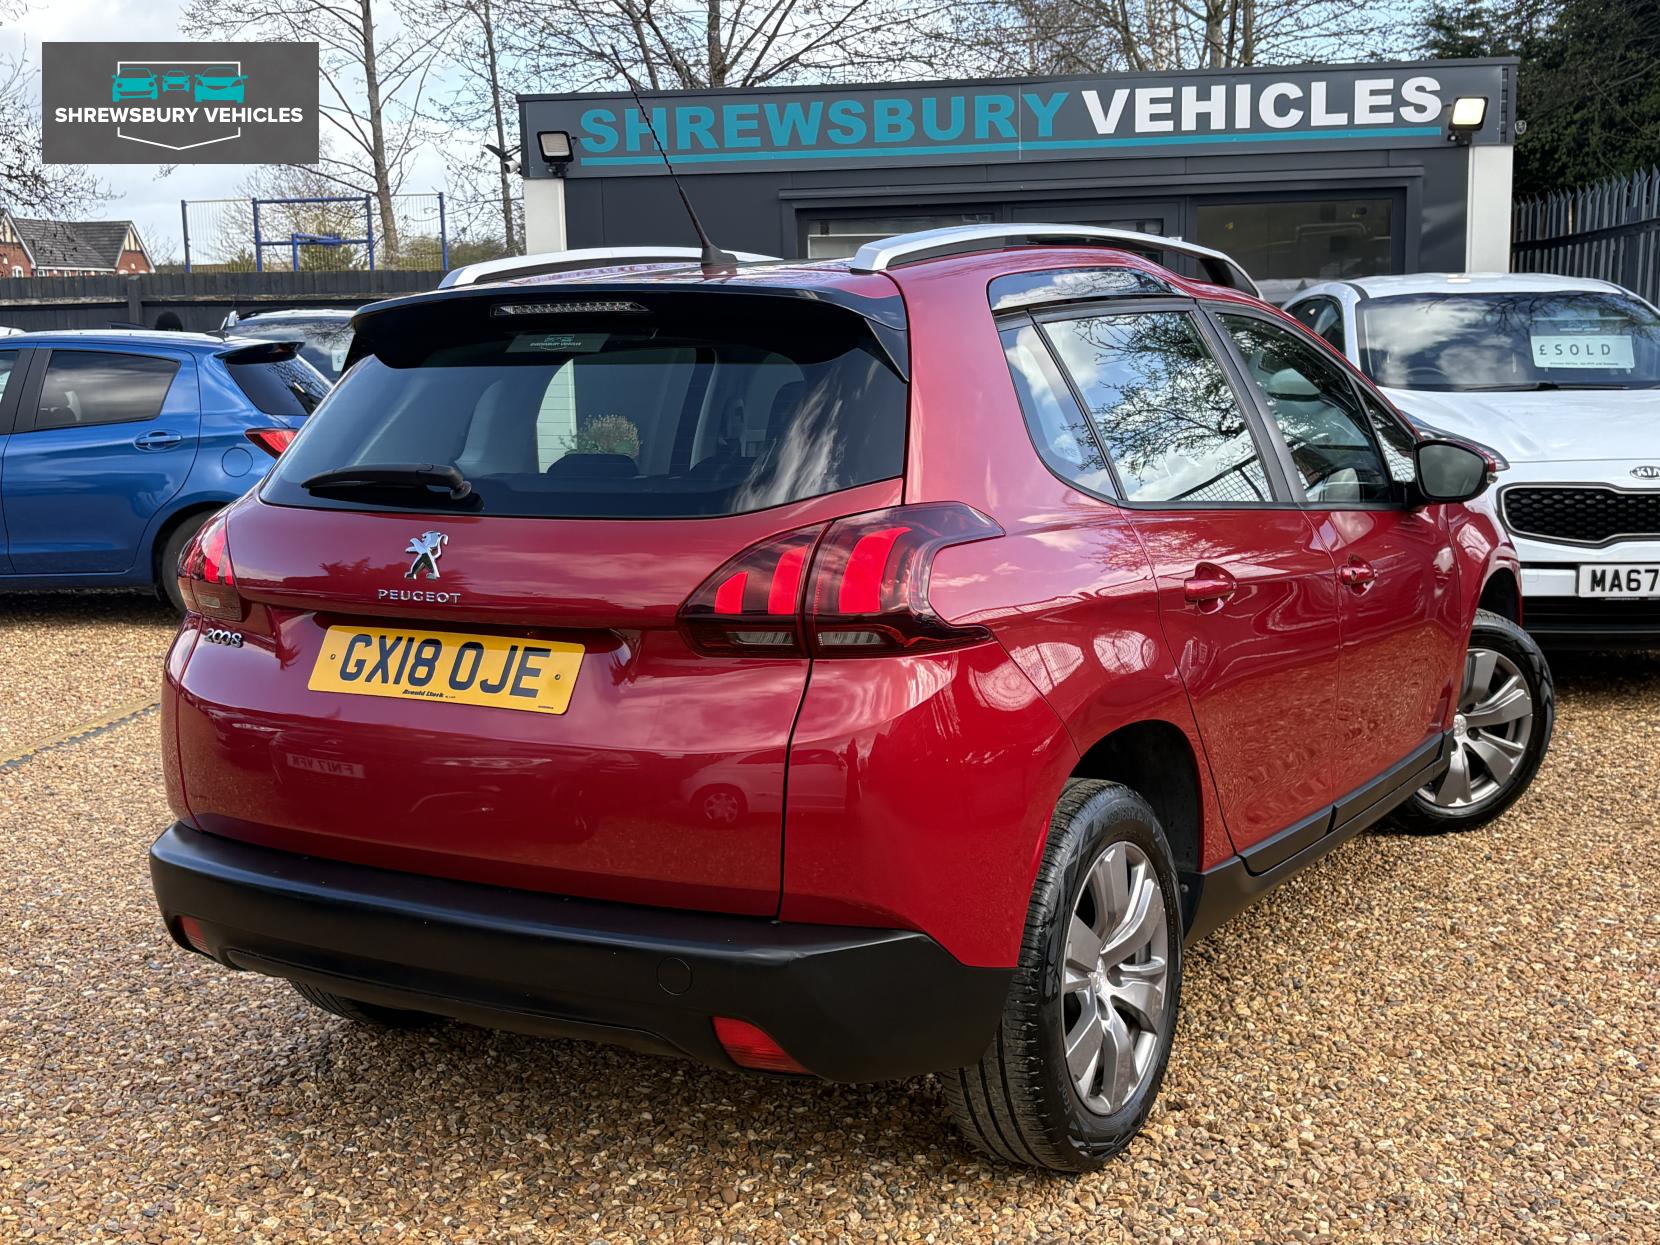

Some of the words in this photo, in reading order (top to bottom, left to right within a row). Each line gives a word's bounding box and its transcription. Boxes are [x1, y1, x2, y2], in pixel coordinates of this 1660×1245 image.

[580, 91, 1069, 153] SHREWSBURY
[1081, 76, 1442, 135] VEHICLES
[1590, 568, 1660, 593] MA67
[378, 589, 461, 604] PEUGEOT
[204, 627, 244, 649] 2008
[339, 633, 442, 687] GX18
[448, 641, 552, 698] OJE
